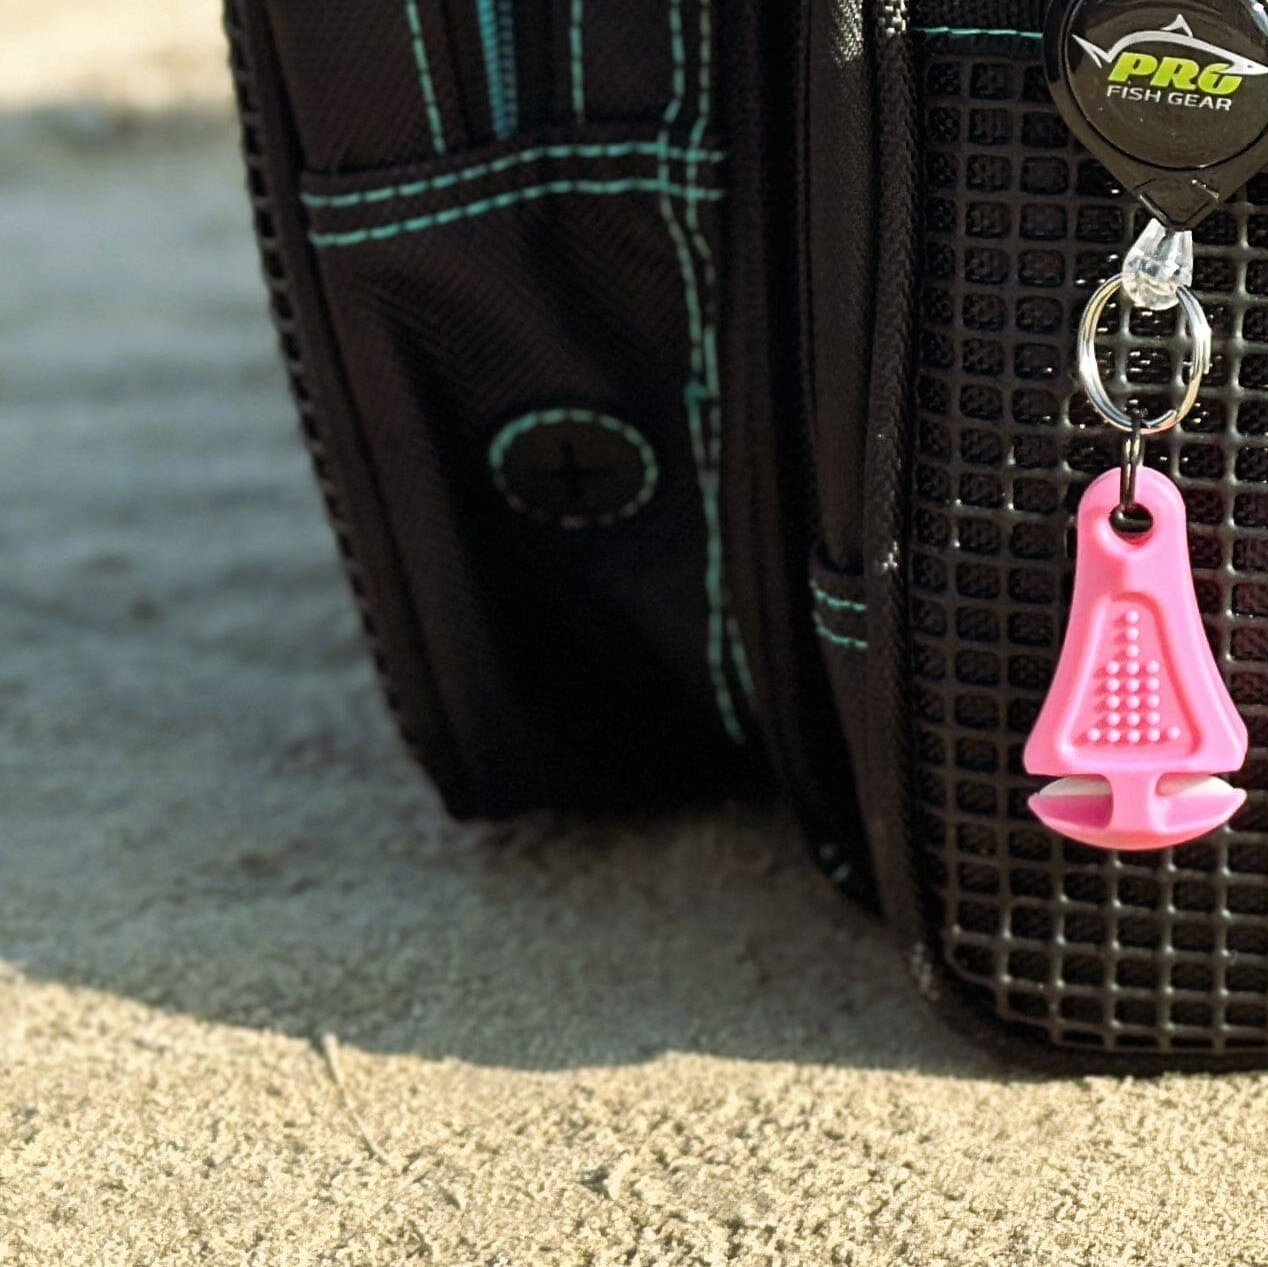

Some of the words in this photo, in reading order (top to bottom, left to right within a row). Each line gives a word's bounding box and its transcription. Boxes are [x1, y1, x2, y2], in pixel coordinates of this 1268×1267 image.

[1107, 51, 1243, 96] PRO
[1106, 84, 1161, 104] FISH
[1166, 92, 1233, 112] GEAR
